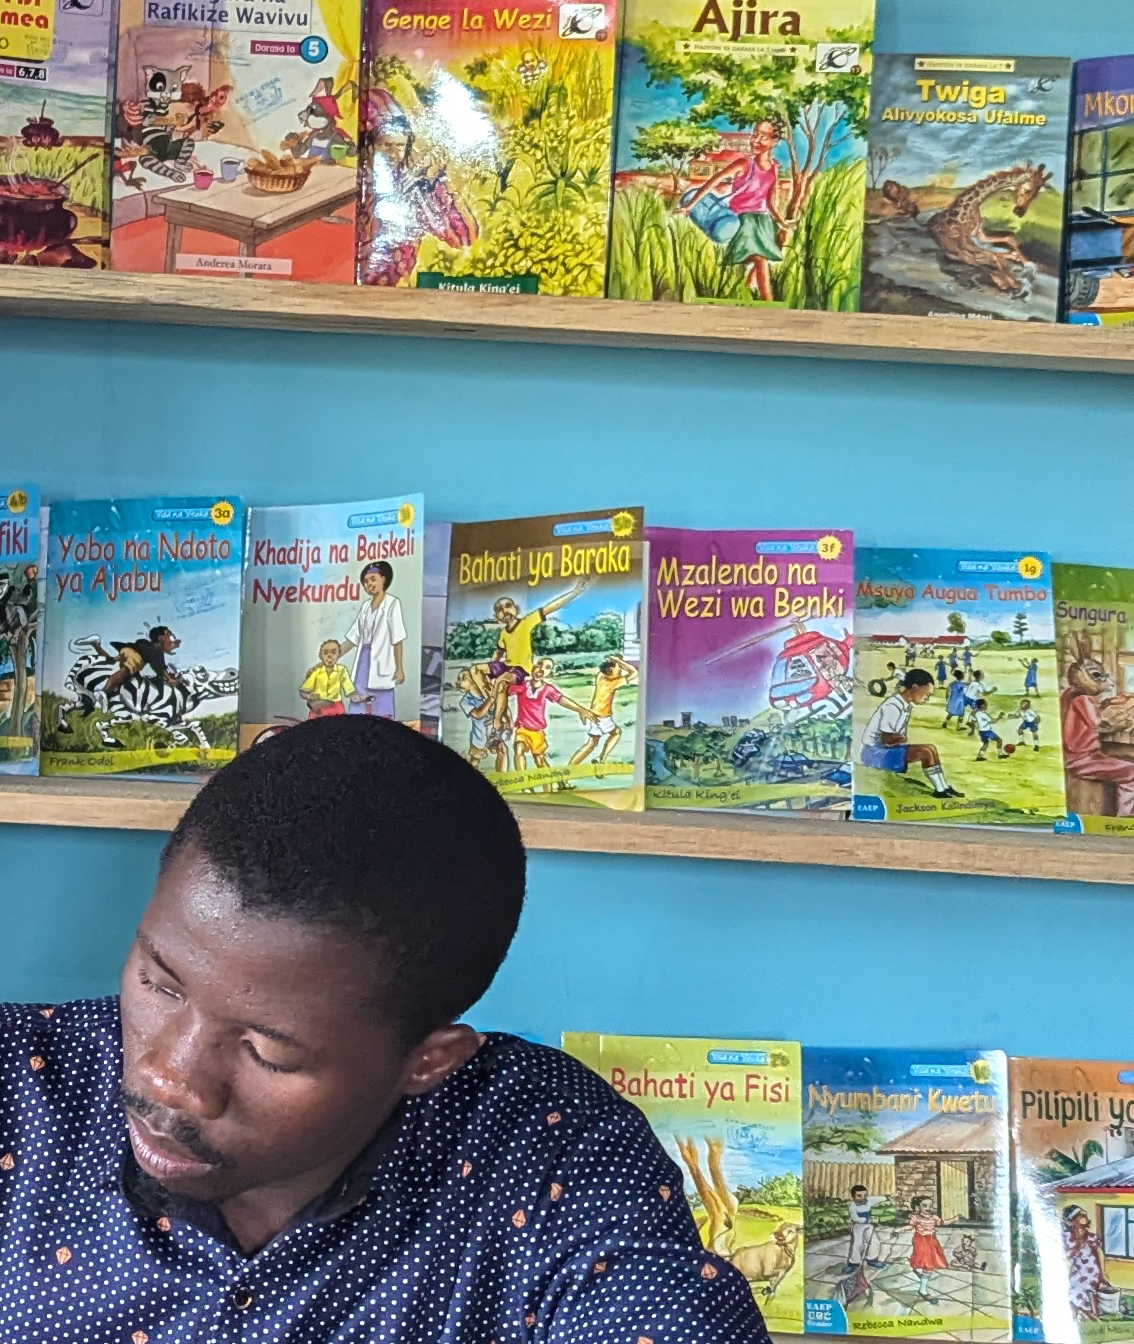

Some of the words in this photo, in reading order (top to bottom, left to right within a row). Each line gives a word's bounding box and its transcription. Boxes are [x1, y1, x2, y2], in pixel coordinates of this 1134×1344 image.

[148, 2, 229, 23] Rafikize
[236, 8, 308, 26] Wavivu
[382, 8, 451, 36] Genge
[462, 8, 482, 29] la
[494, 8, 552, 30] Wezi
[255, 43, 283, 53] Darasa
[308, 41, 319, 55] 5
[18, 68, 46, 80] 6,7,8
[916, 79, 1006, 108] Twiga
[882, 106, 977, 125] Alivyokosa
[984, 109, 1047, 126] Ufalme
[58, 533, 115, 564] Yobo
[123, 540, 150, 562] na
[159, 532, 230, 562] Ndoto
[253, 539, 321, 573] Khadija
[329, 541, 348, 563] na
[357, 530, 415, 561] Baiskeli
[459, 552, 521, 585] Bahati
[528, 555, 553, 587] ya
[561, 542, 630, 576] Baraka
[657, 555, 778, 587] Mzalendo
[787, 562, 816, 585] na
[56, 573, 83, 603] ya
[91, 569, 162, 601] Ajabu
[253, 577, 360, 611] Nyekundu
[857, 582, 915, 601] Msuya
[922, 585, 978, 605] Augua
[984, 584, 1047, 602] Tumbo
[657, 588, 721, 620] Wezi
[731, 593, 764, 618] wa
[774, 587, 845, 619] Benki
[1055, 600, 1126, 627] Sungura
[611, 1066, 695, 1100] Bahati
[706, 1077, 735, 1108] ya
[745, 1075, 790, 1103] Fisi
[808, 1086, 923, 1117] Nyumbani
